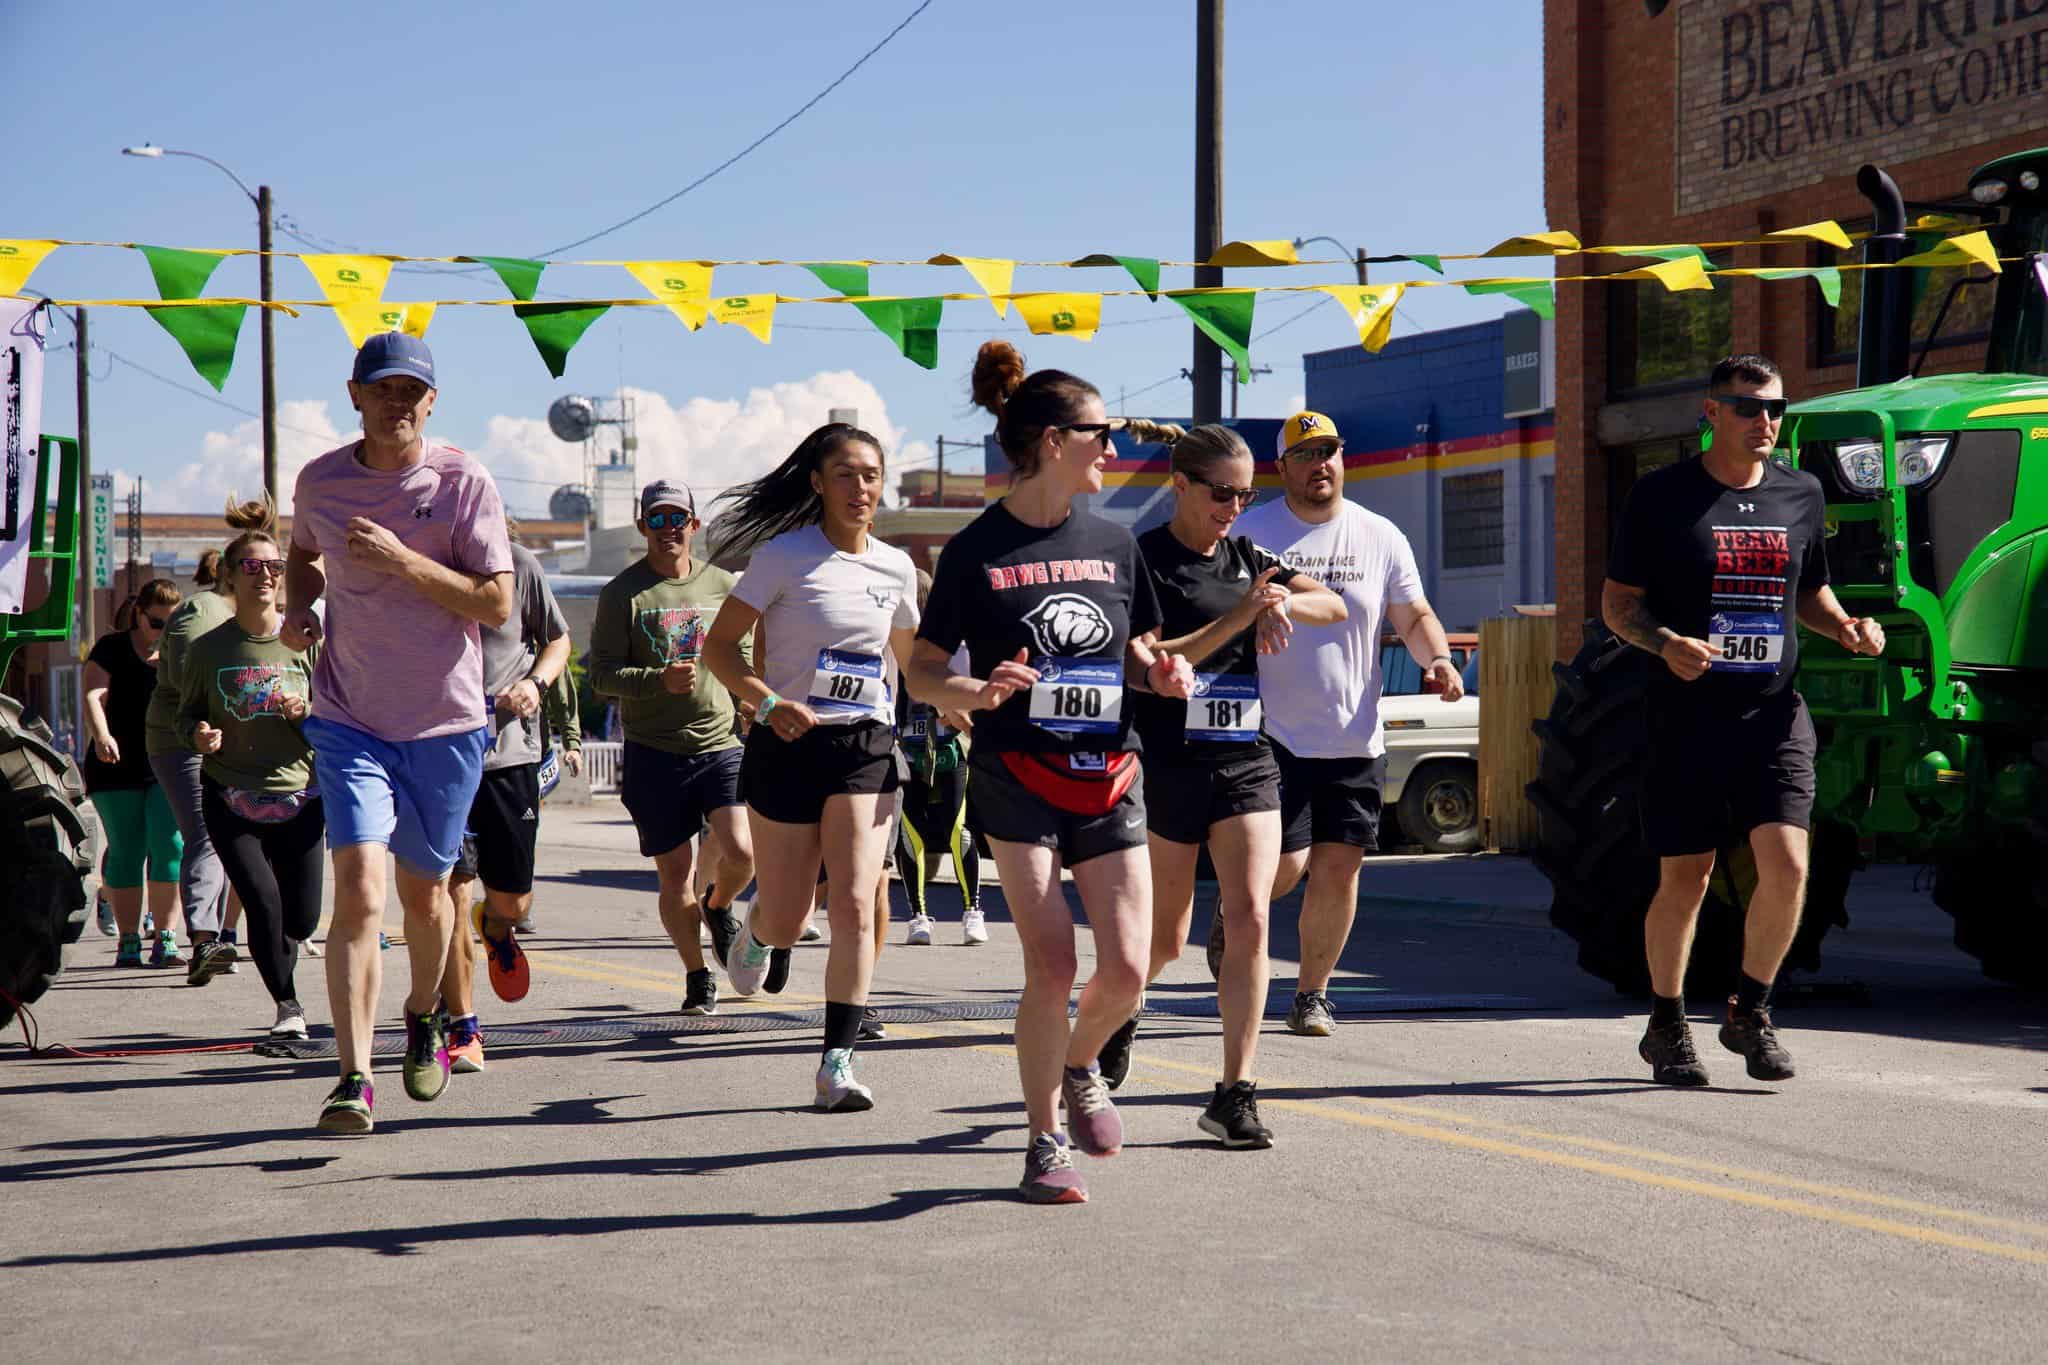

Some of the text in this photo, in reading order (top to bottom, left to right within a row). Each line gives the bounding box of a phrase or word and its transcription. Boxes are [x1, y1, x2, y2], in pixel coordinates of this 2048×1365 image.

[1721, 0, 2048, 105] BEAVER
[1721, 67, 1915, 170] BREWING
[1300, 415, 1321, 432] M
[95, 495, 106, 587] SOUVENIRS
[1713, 532, 1788, 551] TEAM
[988, 559, 1116, 590] DAWG FAMILY
[1716, 552, 1789, 573] BEEF
[1722, 636, 1768, 661] 546
[829, 674, 864, 701] 187
[1051, 686, 1102, 718] 180
[1205, 700, 1242, 728] 181
